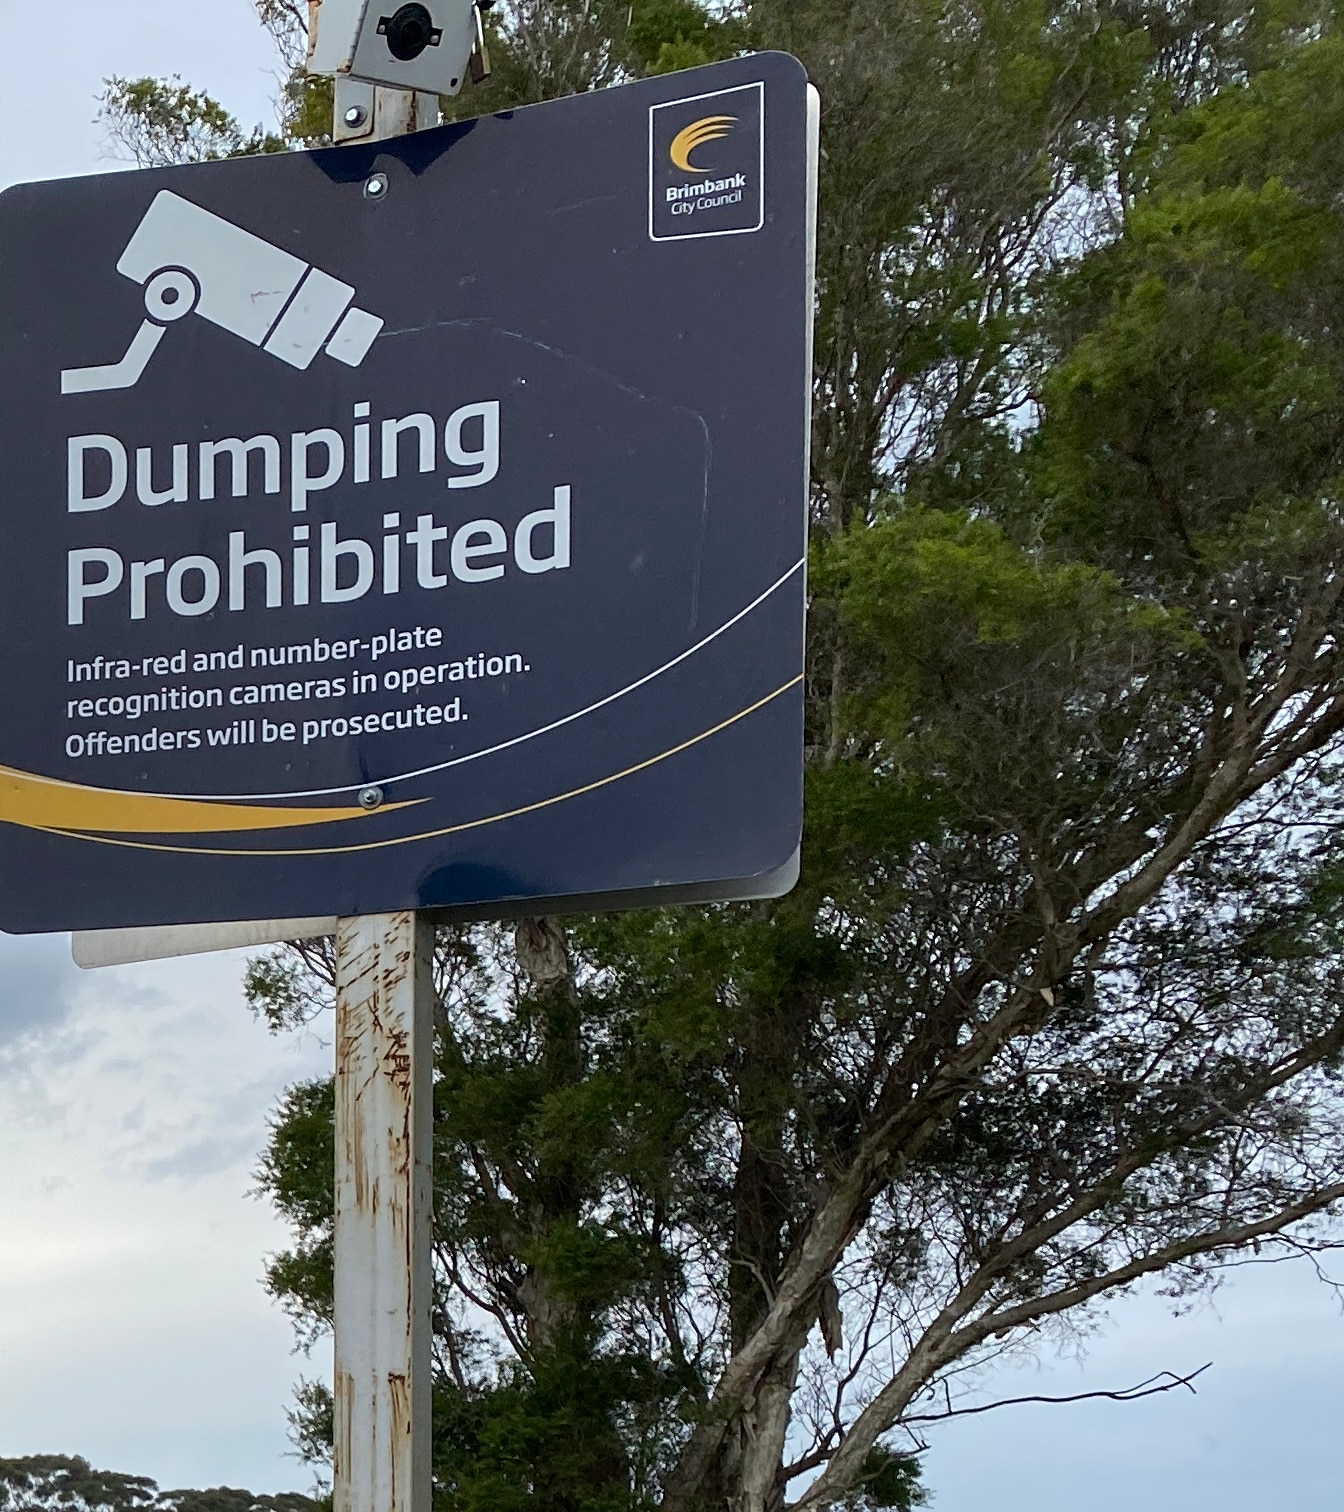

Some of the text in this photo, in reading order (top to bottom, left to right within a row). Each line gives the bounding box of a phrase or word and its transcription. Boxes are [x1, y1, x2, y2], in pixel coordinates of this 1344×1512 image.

[666, 173, 746, 201] Brimbank
[671, 190, 742, 215] City Council
[67, 400, 500, 513] Dumping
[67, 484, 571, 625] Prohibited
[67, 626, 442, 682] Infra-red and number-plate
[67, 652, 530, 719] recognition cameras in operation.
[65, 696, 468, 757] Offenders will be prosecuted.
